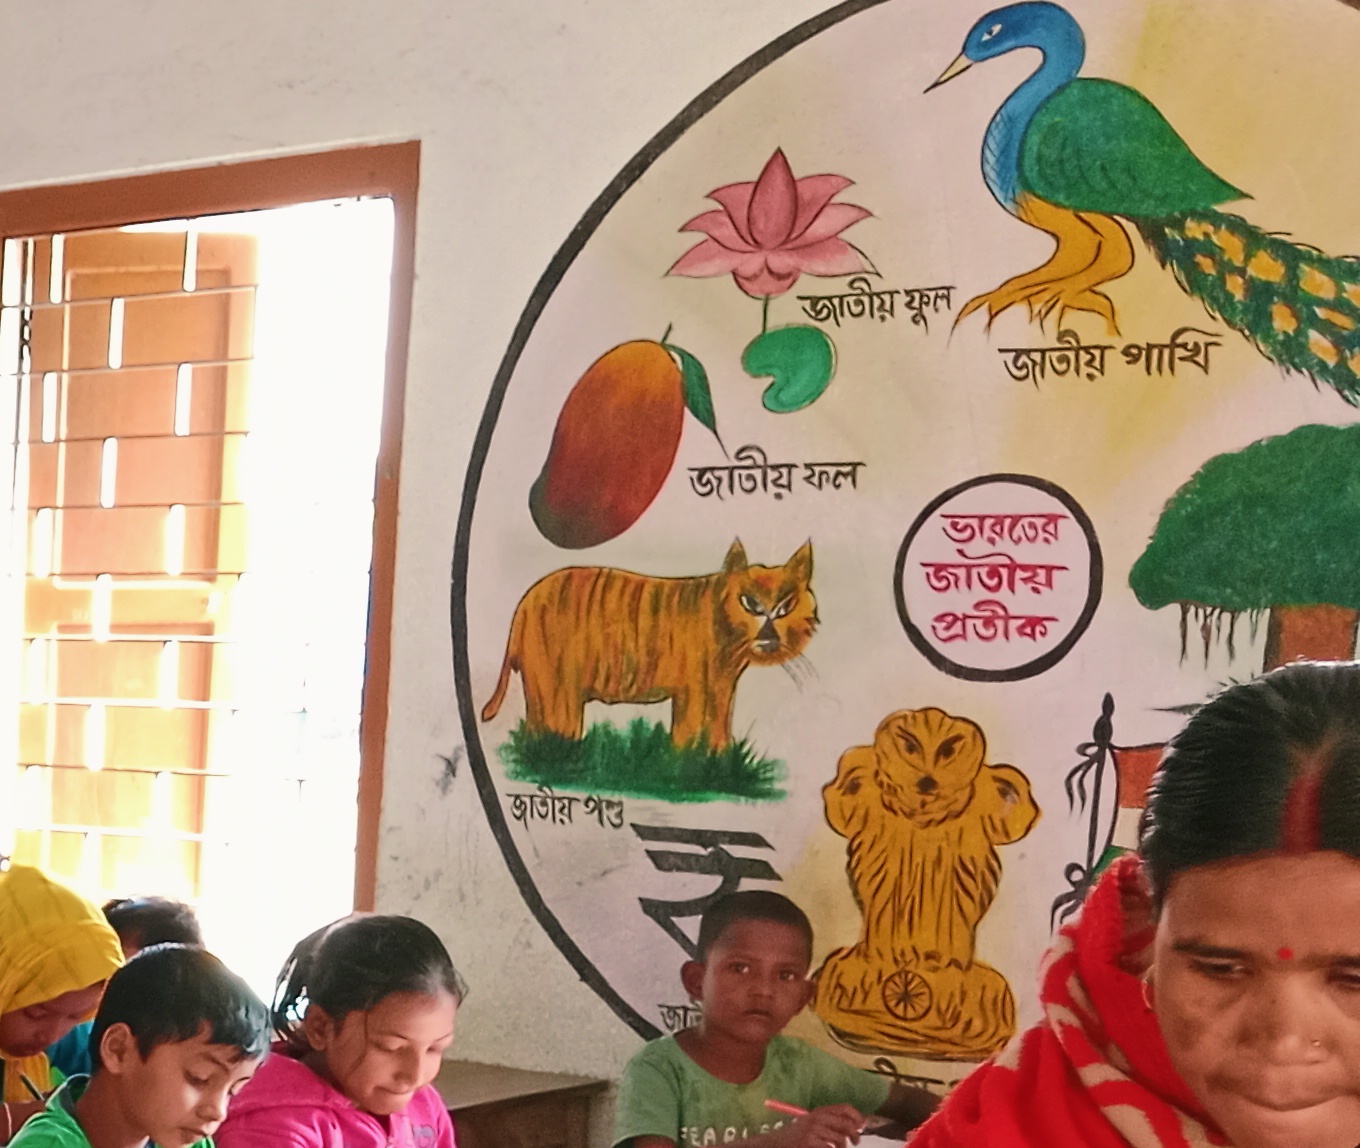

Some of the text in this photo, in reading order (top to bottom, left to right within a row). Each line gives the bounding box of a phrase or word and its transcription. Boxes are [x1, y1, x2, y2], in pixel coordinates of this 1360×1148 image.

[797, 276, 956, 340] জাতীয় ফুল
[998, 327, 1224, 389] জাতীয় পাখি
[688, 444, 867, 500] জাতীয় ফল
[940, 513, 1069, 547] ভারতের
[920, 547, 1068, 596] জাতীয়
[930, 599, 1059, 647] প্রতীক
[506, 784, 581, 830] জাতীয়
